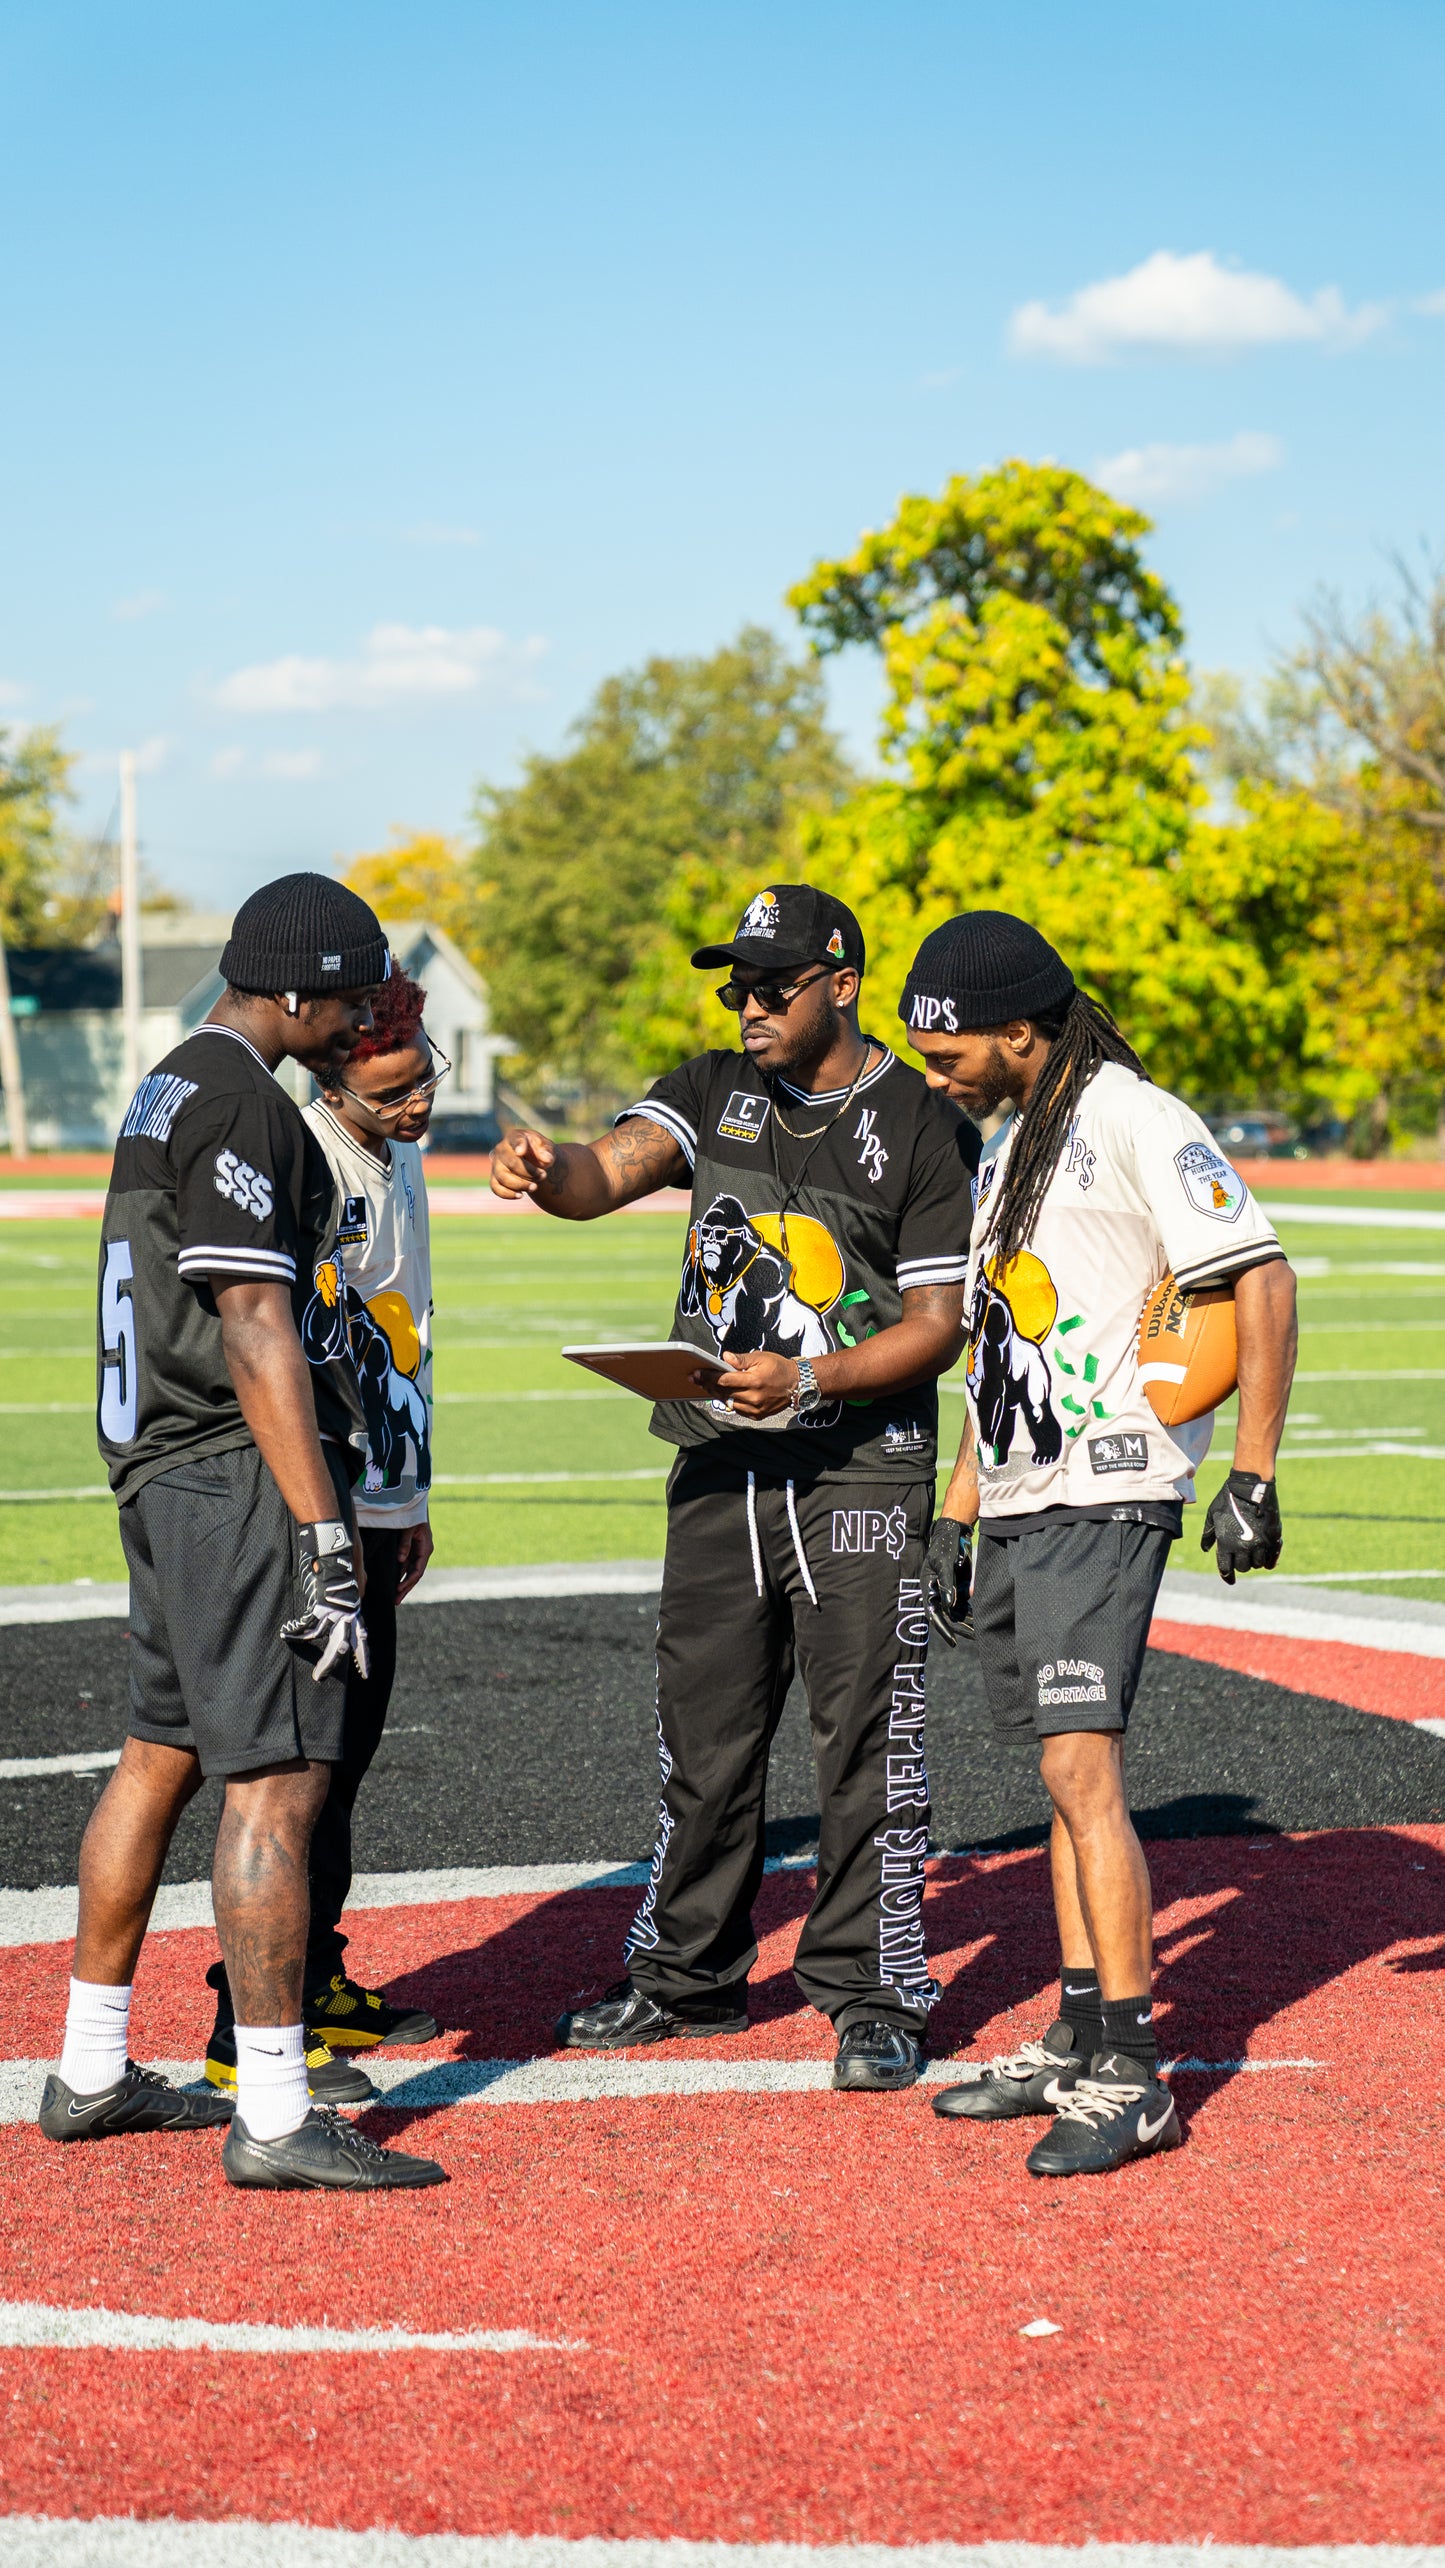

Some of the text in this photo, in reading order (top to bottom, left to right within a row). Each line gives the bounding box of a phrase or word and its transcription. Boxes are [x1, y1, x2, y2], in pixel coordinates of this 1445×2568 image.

[909, 994, 959, 1034] NP$
[739, 1098, 756, 1119] C
[1197, 1170, 1228, 1184] THE YEAR
[346, 1199, 357, 1223] C
[1147, 1280, 1176, 1339] Wilson
[101, 1239, 138, 1444] 5
[913, 1421, 921, 1440] L
[1124, 1436, 1143, 1457] M
[831, 1505, 907, 1561] NP$
[1036, 1658, 1104, 1688] NO PAPER
[886, 1662, 930, 1814] PAPER
